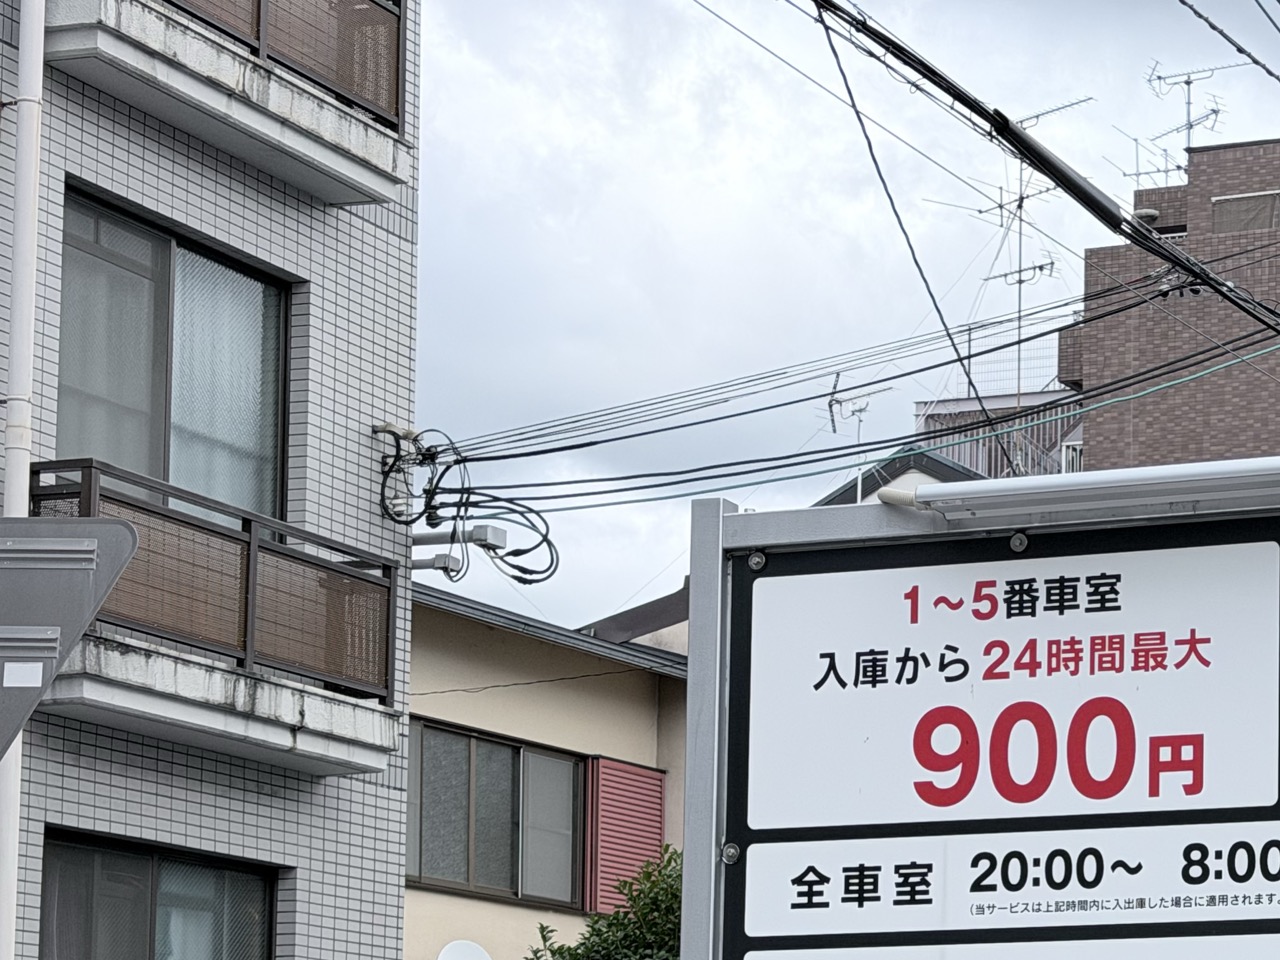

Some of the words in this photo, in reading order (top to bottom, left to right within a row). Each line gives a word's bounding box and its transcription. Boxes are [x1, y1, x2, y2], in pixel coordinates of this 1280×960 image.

[912, 696, 1205, 808] 900円
[790, 860, 934, 910] 全車室
